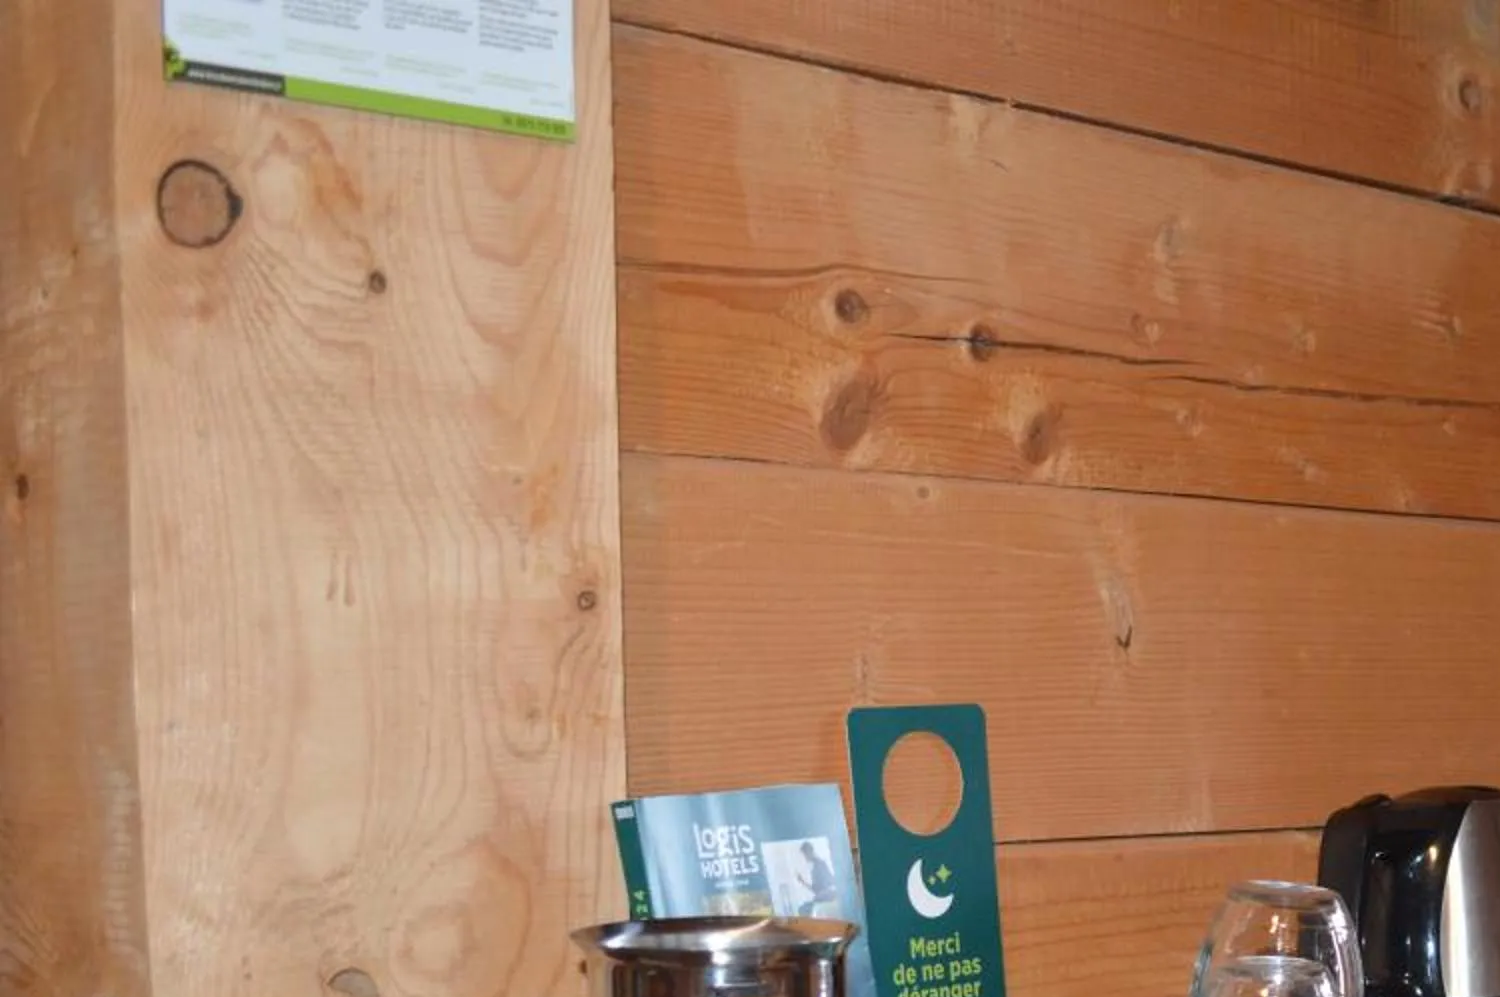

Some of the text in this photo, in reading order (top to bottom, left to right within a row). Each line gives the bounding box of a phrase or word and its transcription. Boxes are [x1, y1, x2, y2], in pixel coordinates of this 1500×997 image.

[700, 854, 760, 880] HOTELS
[909, 930, 961, 960] Merci
[892, 957, 983, 986] de ne pas
